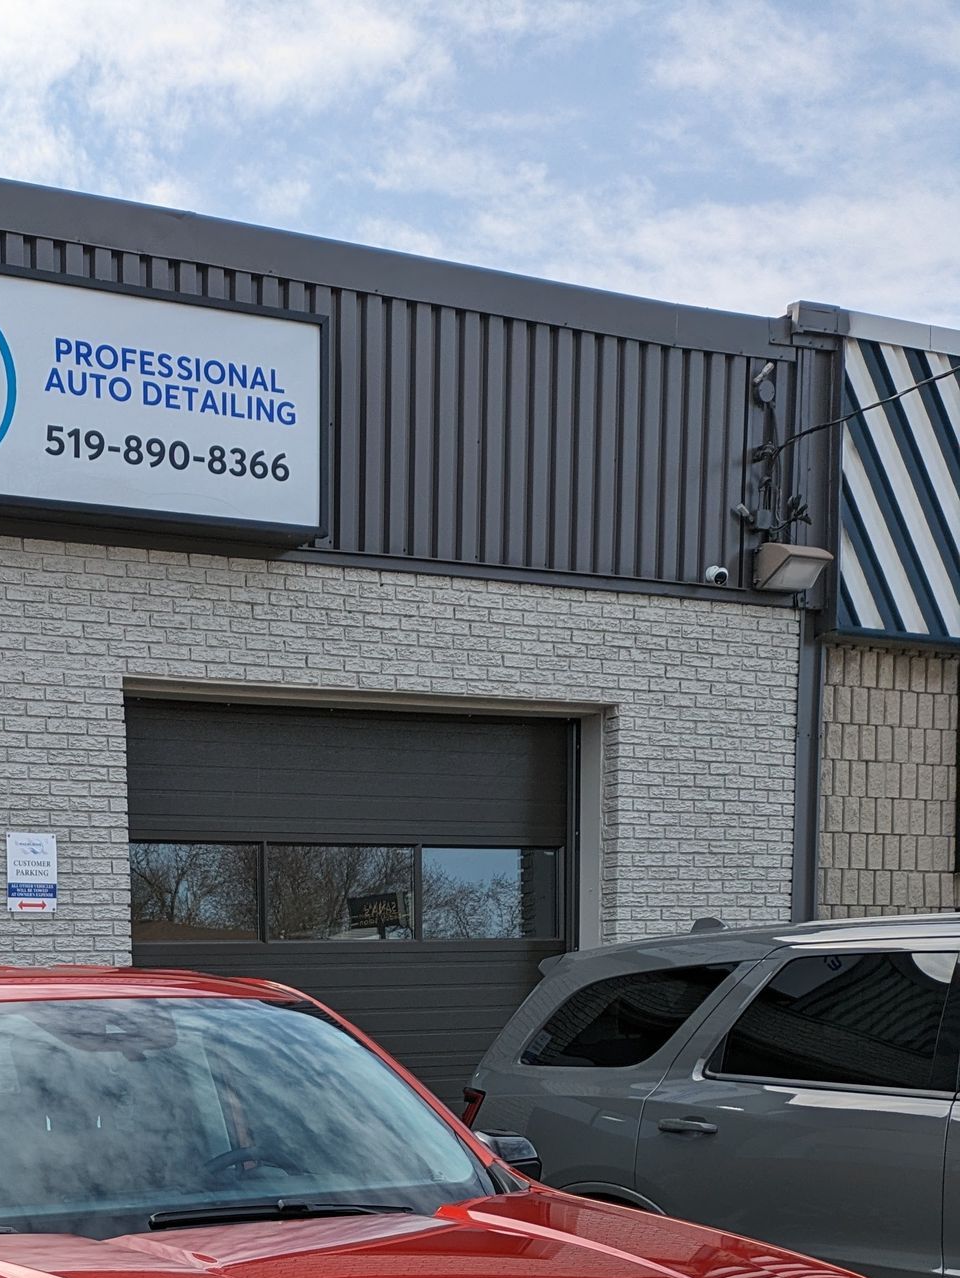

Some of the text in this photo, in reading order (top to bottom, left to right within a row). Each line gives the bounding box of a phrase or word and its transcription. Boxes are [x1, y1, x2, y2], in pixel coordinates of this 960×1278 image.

[55, 337, 285, 394] PROFESSIONAL
[44, 367, 297, 426] AUTO DETAILING
[44, 424, 290, 482] 519-890-8366
[16, 869, 49, 877] PARKING
